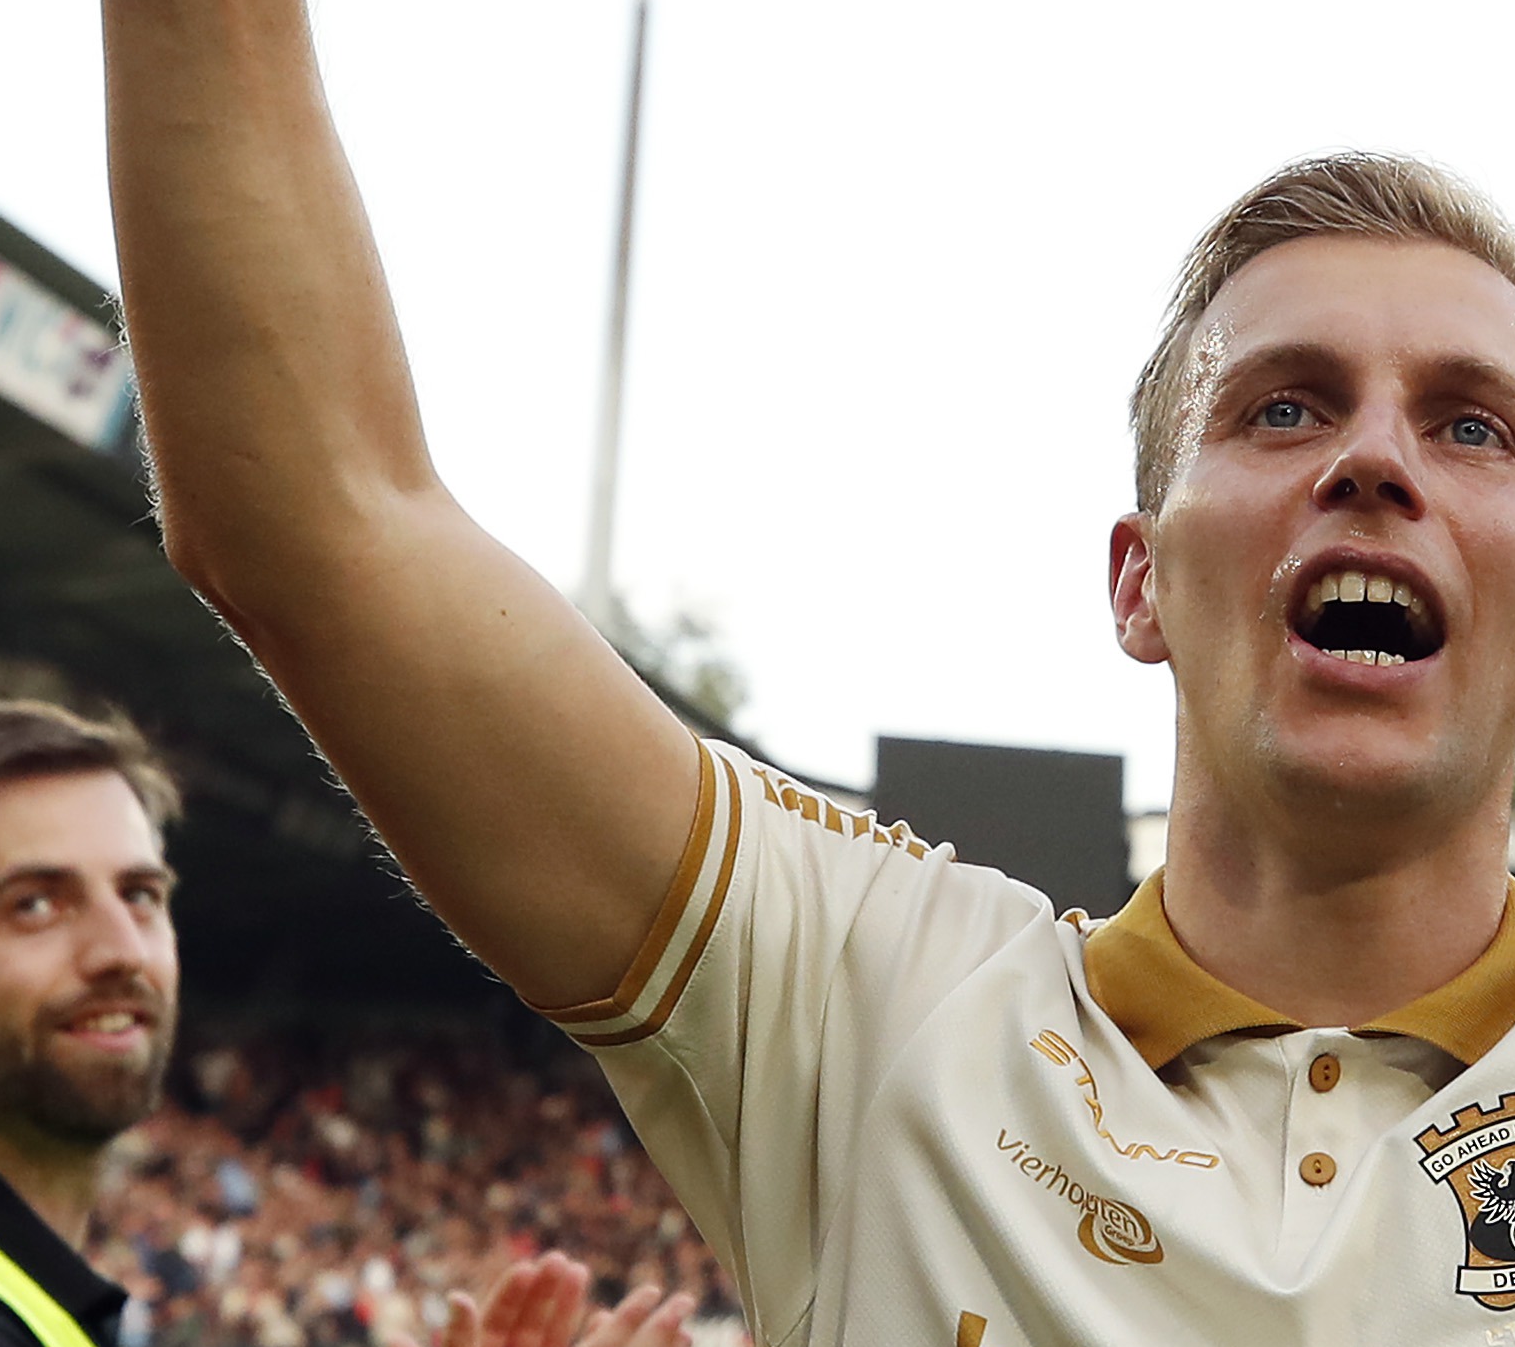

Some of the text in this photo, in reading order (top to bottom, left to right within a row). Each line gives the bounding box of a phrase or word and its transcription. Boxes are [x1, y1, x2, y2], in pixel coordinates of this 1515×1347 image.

[1029, 1029, 1221, 1169] STANNO
[1431, 1153, 1455, 1173] GO
[1457, 1130, 1510, 1160] AHEAD
